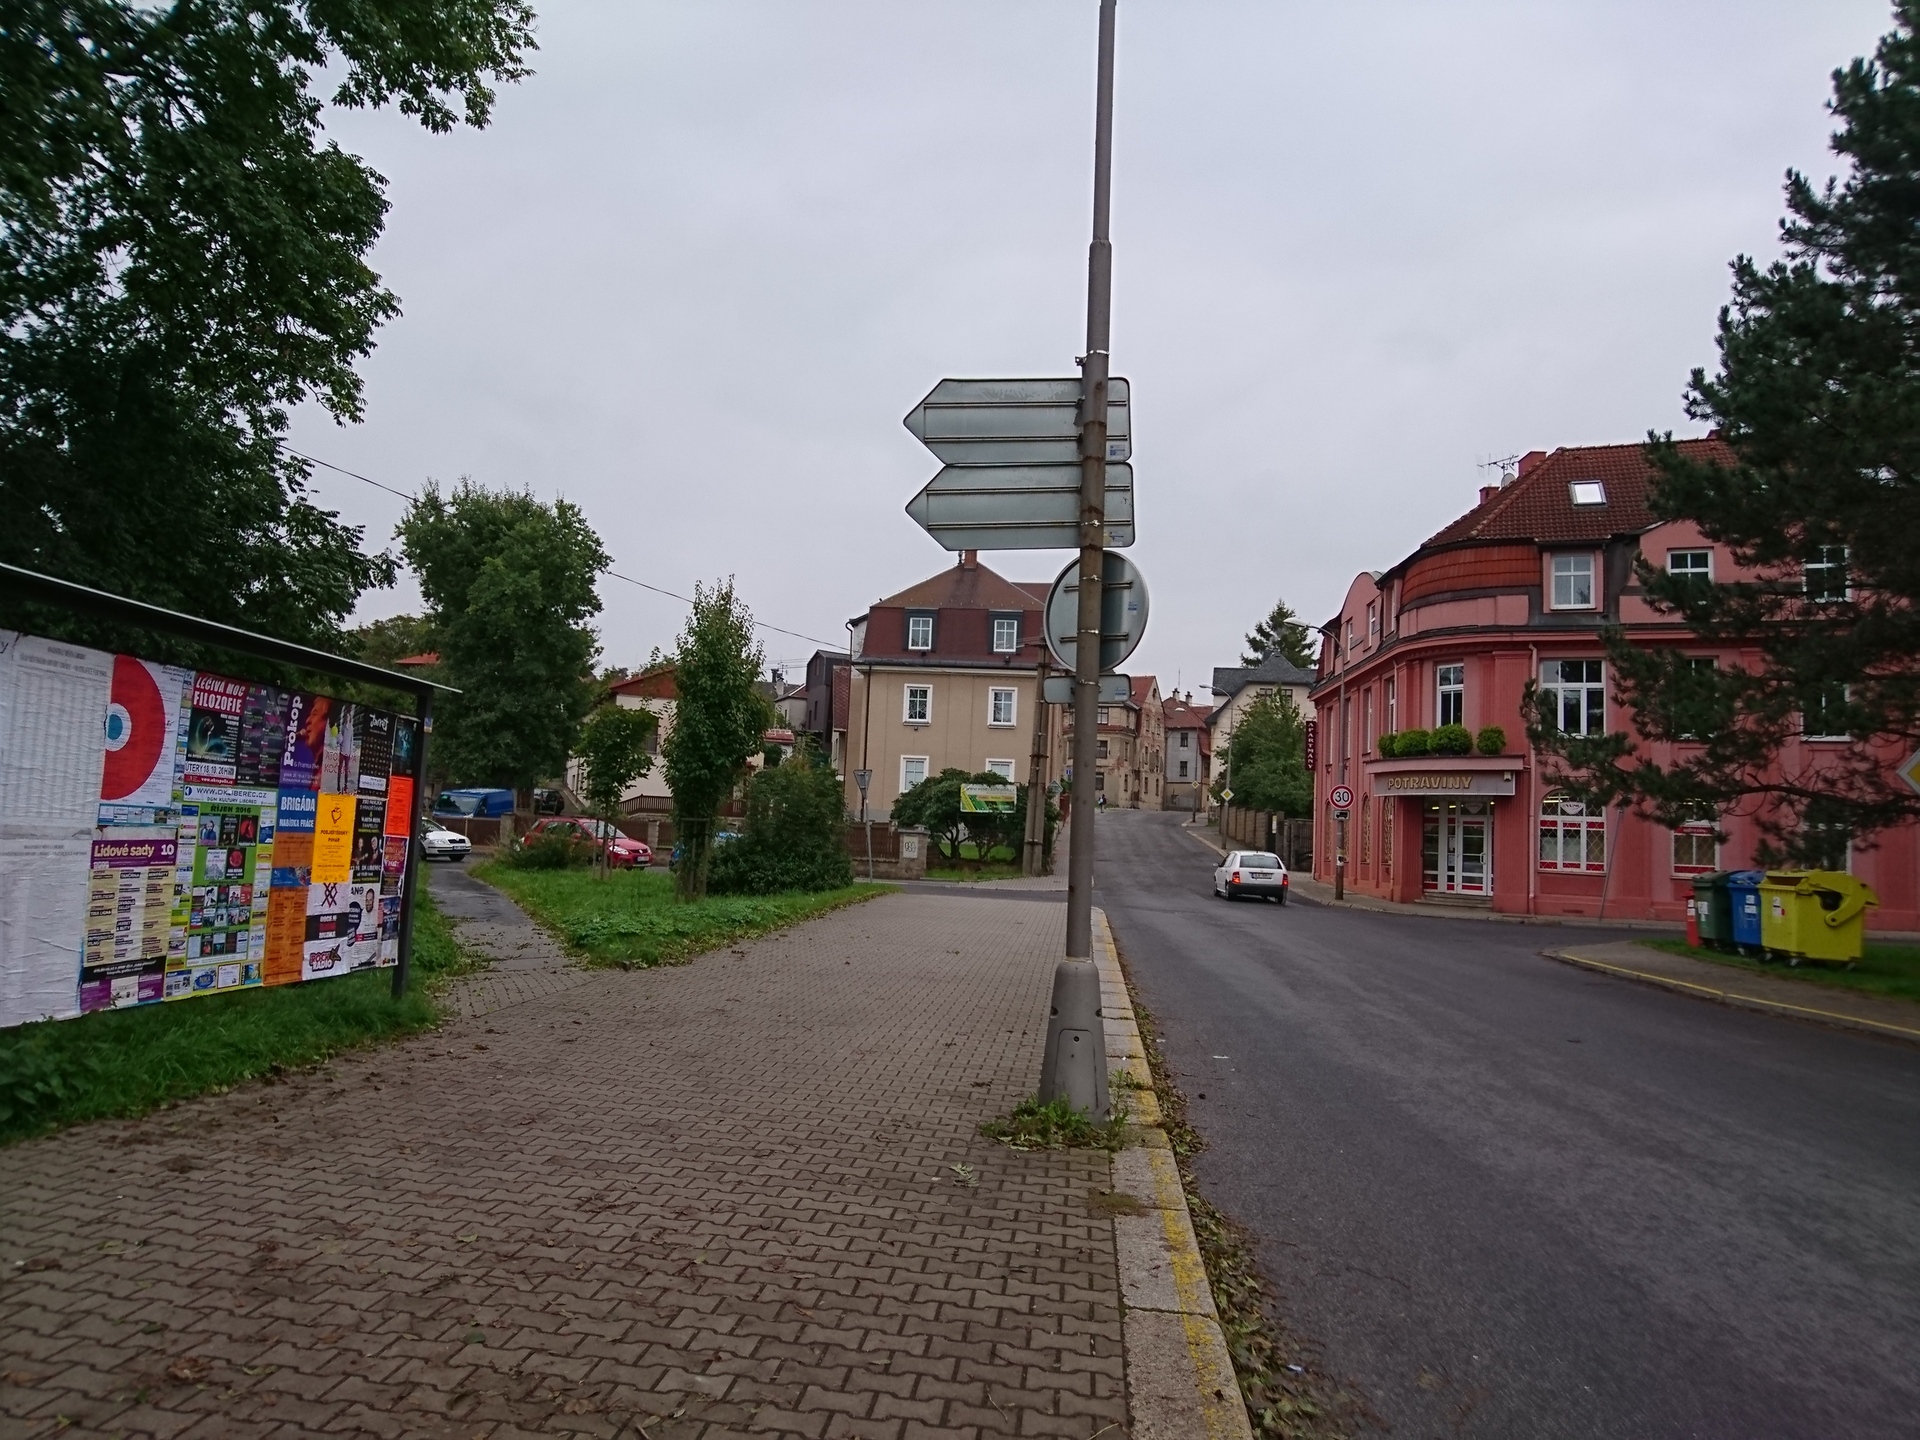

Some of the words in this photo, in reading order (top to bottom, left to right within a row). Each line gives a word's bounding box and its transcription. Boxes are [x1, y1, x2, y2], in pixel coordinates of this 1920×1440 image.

[226, 683, 246, 697] MOC
[193, 691, 242, 713] FILOZOFIE
[283, 695, 303, 767] Prokop
[1388, 776, 1473, 790] POTRAVINY
[280, 795, 315, 812] BRIGÁDA
[1334, 791, 1350, 802] 30
[279, 818, 299, 828] NABÍDKA
[300, 818, 314, 828] PRÁCE
[94, 843, 130, 857] Lidové
[130, 844, 154, 857] sady
[161, 844, 175, 856] 10
[312, 960, 332, 971] RADIO
